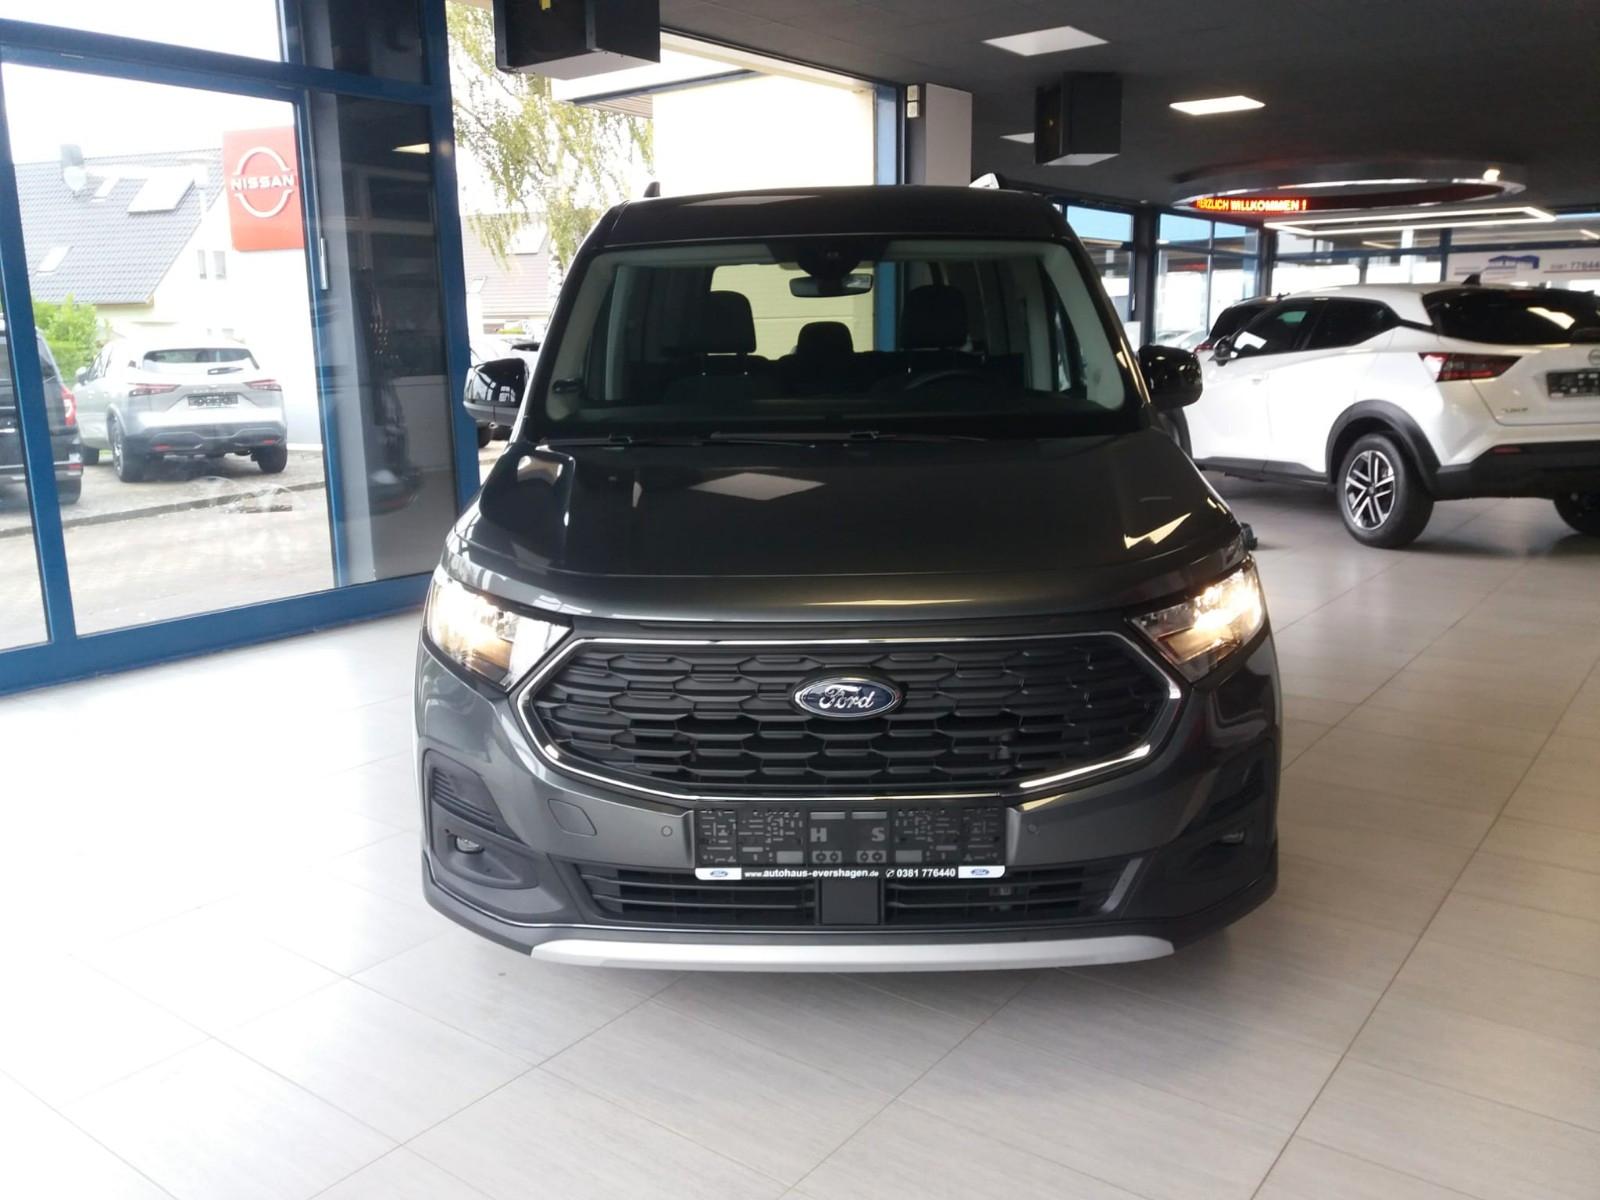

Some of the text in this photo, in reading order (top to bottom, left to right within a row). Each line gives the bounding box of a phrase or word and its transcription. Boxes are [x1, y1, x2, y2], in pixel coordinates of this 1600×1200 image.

[231, 174, 295, 191] NISSAN
[1196, 198, 1229, 210] HERZLICH
[1230, 199, 1300, 211] WILLKOMMEN
[819, 684, 876, 709] Ford
[744, 867, 956, 879] www.autohaus-evershagen.de 0381 776440
